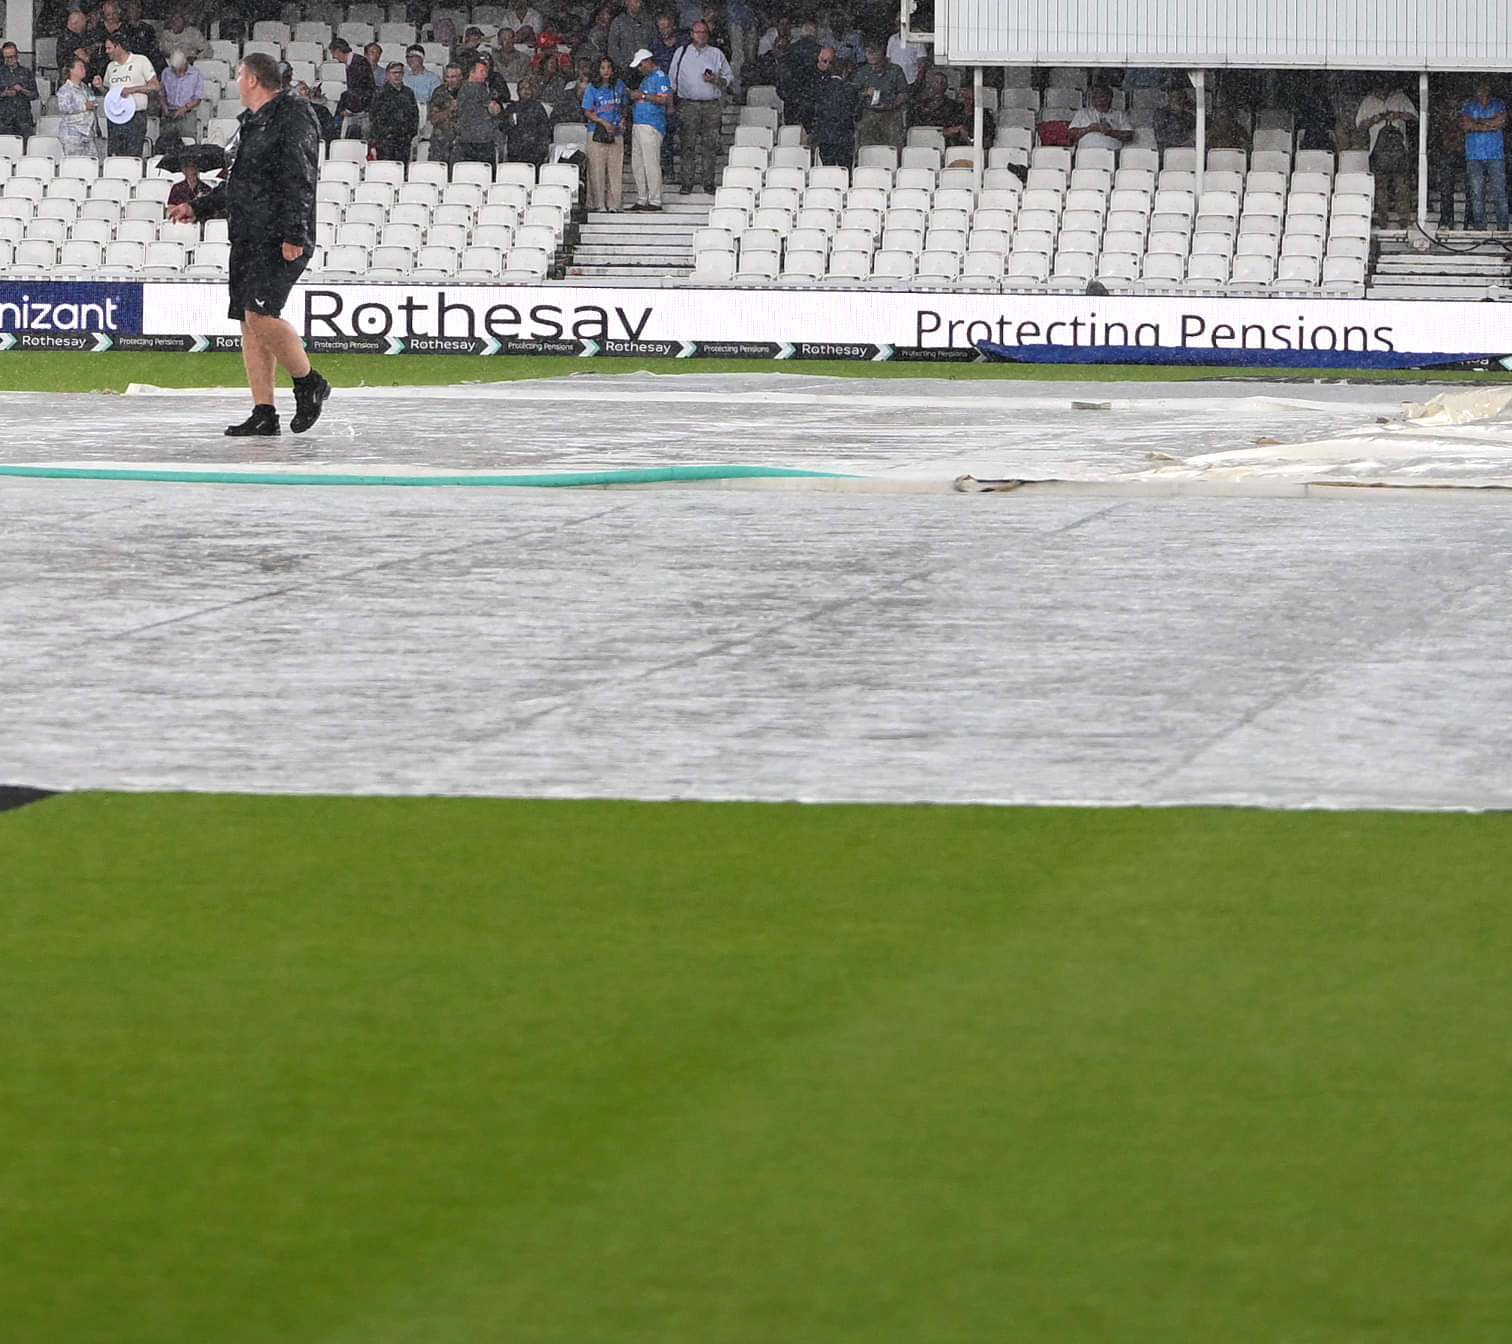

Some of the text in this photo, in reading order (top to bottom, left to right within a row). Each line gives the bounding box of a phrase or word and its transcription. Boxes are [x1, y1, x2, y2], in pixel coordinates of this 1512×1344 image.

[304, 291, 654, 343] Rothesay
[1181, 314, 1394, 352] Pensions
[23, 336, 86, 348] Rothesay
[411, 339, 475, 352] Rothesay
[606, 341, 670, 353] Rothesay
[803, 343, 867, 356] Rothesay
